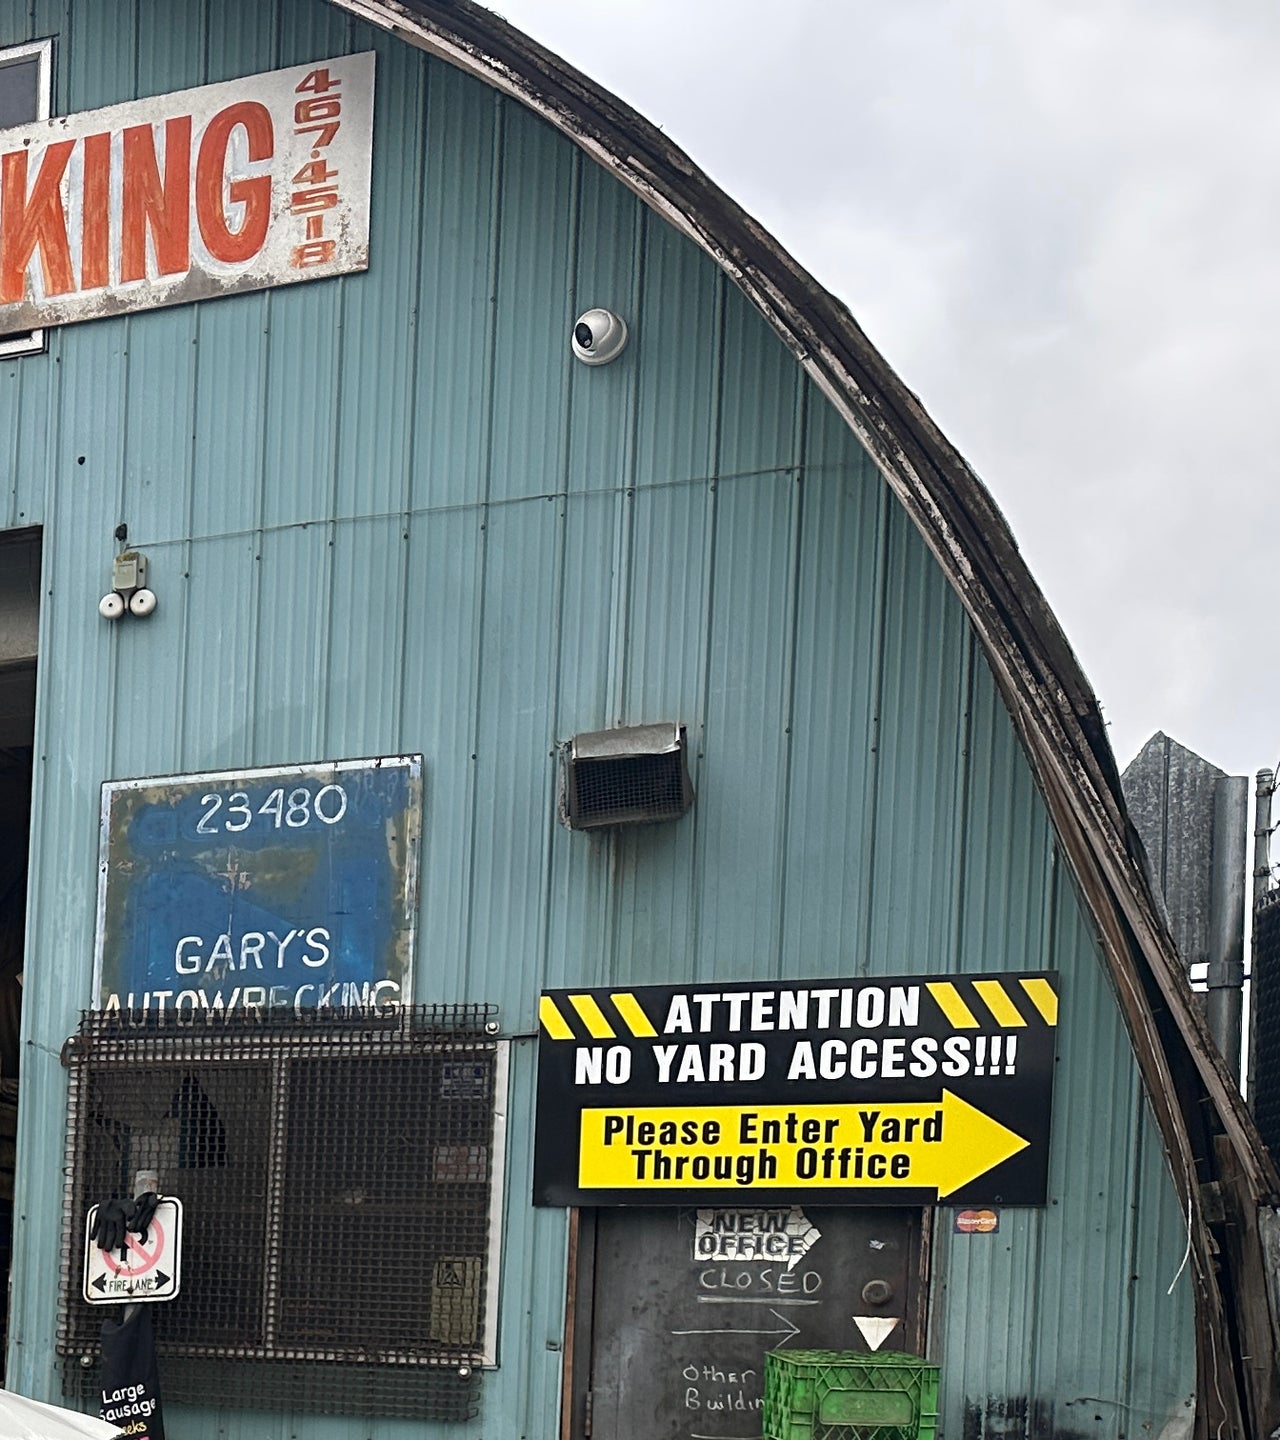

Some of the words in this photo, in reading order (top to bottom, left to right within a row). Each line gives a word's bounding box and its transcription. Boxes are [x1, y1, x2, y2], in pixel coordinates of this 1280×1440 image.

[195, 784, 348, 835] 23480
[175, 927, 331, 975] GARY'S
[663, 986, 920, 1035] ATTENTION
[574, 1046, 632, 1085] NO
[655, 1042, 767, 1083] YARD
[787, 1035, 1018, 1081] ACCESS!!!
[603, 1114, 721, 1147] Please
[738, 1112, 840, 1146] Enter
[858, 1110, 943, 1143] Yard
[631, 1148, 778, 1185] Through
[795, 1146, 911, 1179] Office
[714, 1213, 788, 1232] NEW
[699, 1232, 806, 1255] OFFICE
[108, 1280, 128, 1293] FIRE
[700, 1268, 822, 1293] CLOSED
[682, 1364, 756, 1384] Other
[102, 1383, 145, 1404] Large
[685, 1387, 764, 1412] Buildin
[99, 1398, 156, 1421] Sausage
[122, 1420, 148, 1436] eeks
